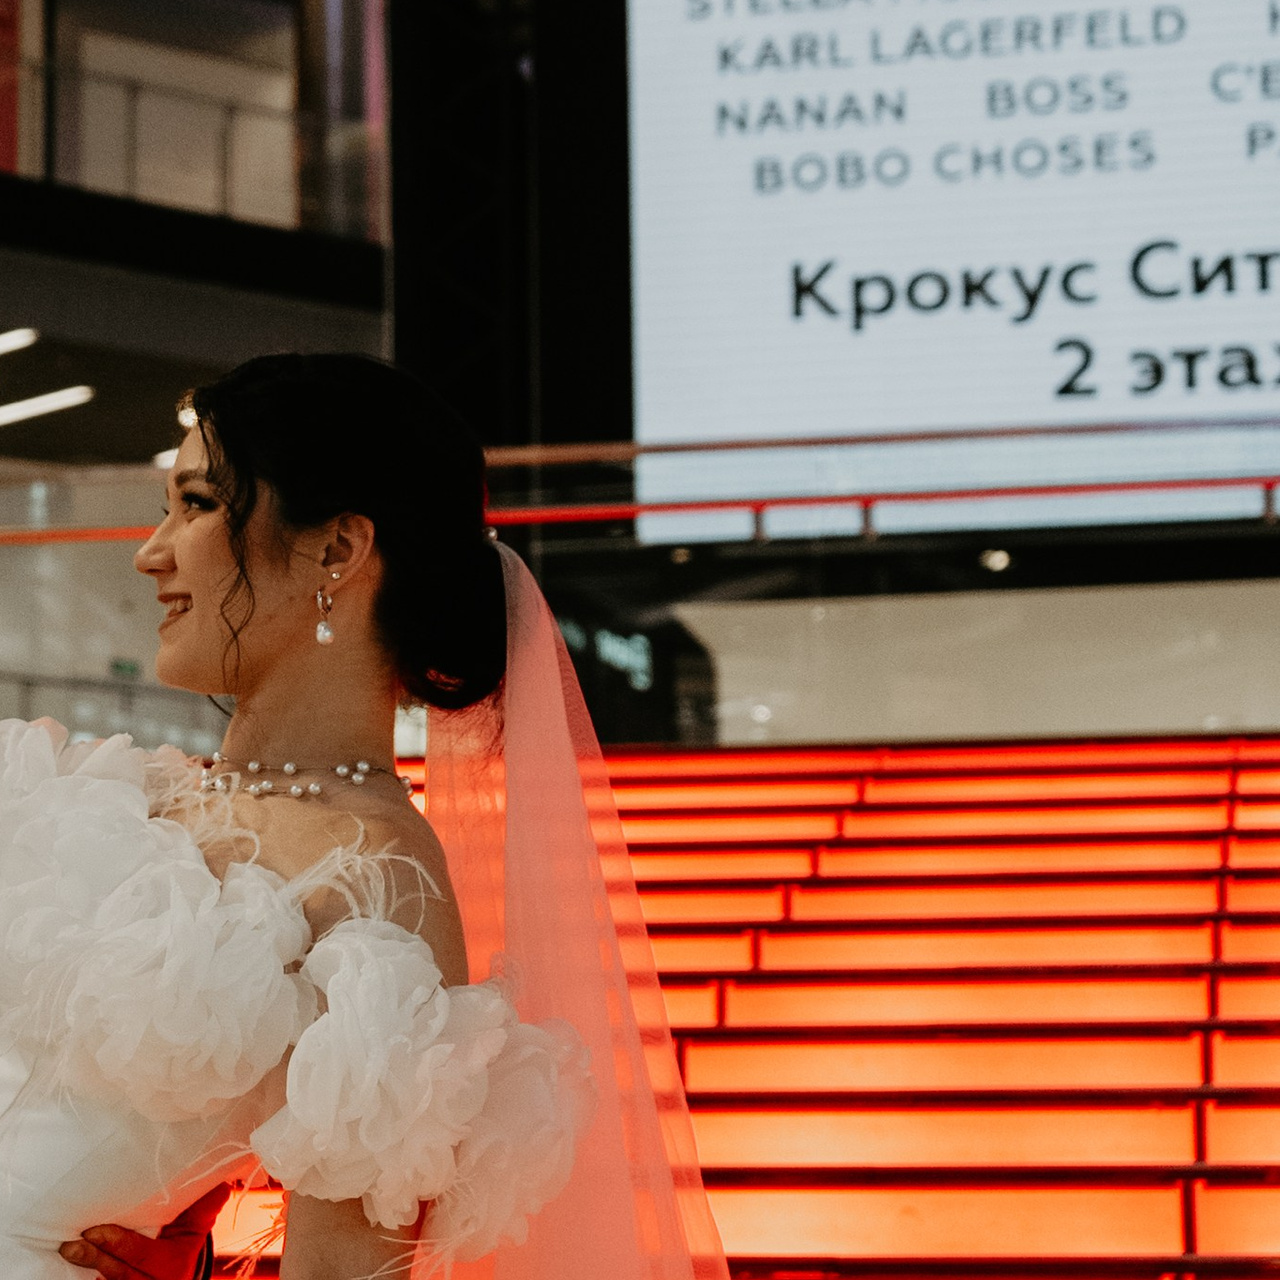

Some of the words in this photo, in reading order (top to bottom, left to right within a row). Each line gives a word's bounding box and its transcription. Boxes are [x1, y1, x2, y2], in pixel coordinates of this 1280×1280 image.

[716, 32, 855, 74] KARL
[869, 6, 1188, 65] LAGERFELD
[715, 91, 907, 135] NANAN
[985, 73, 1130, 119] BOSS
[753, 148, 911, 195] BOBO
[933, 130, 1157, 183] CHOSES
[791, 258, 1098, 332] Крокус
[1055, 337, 1097, 399] 2
